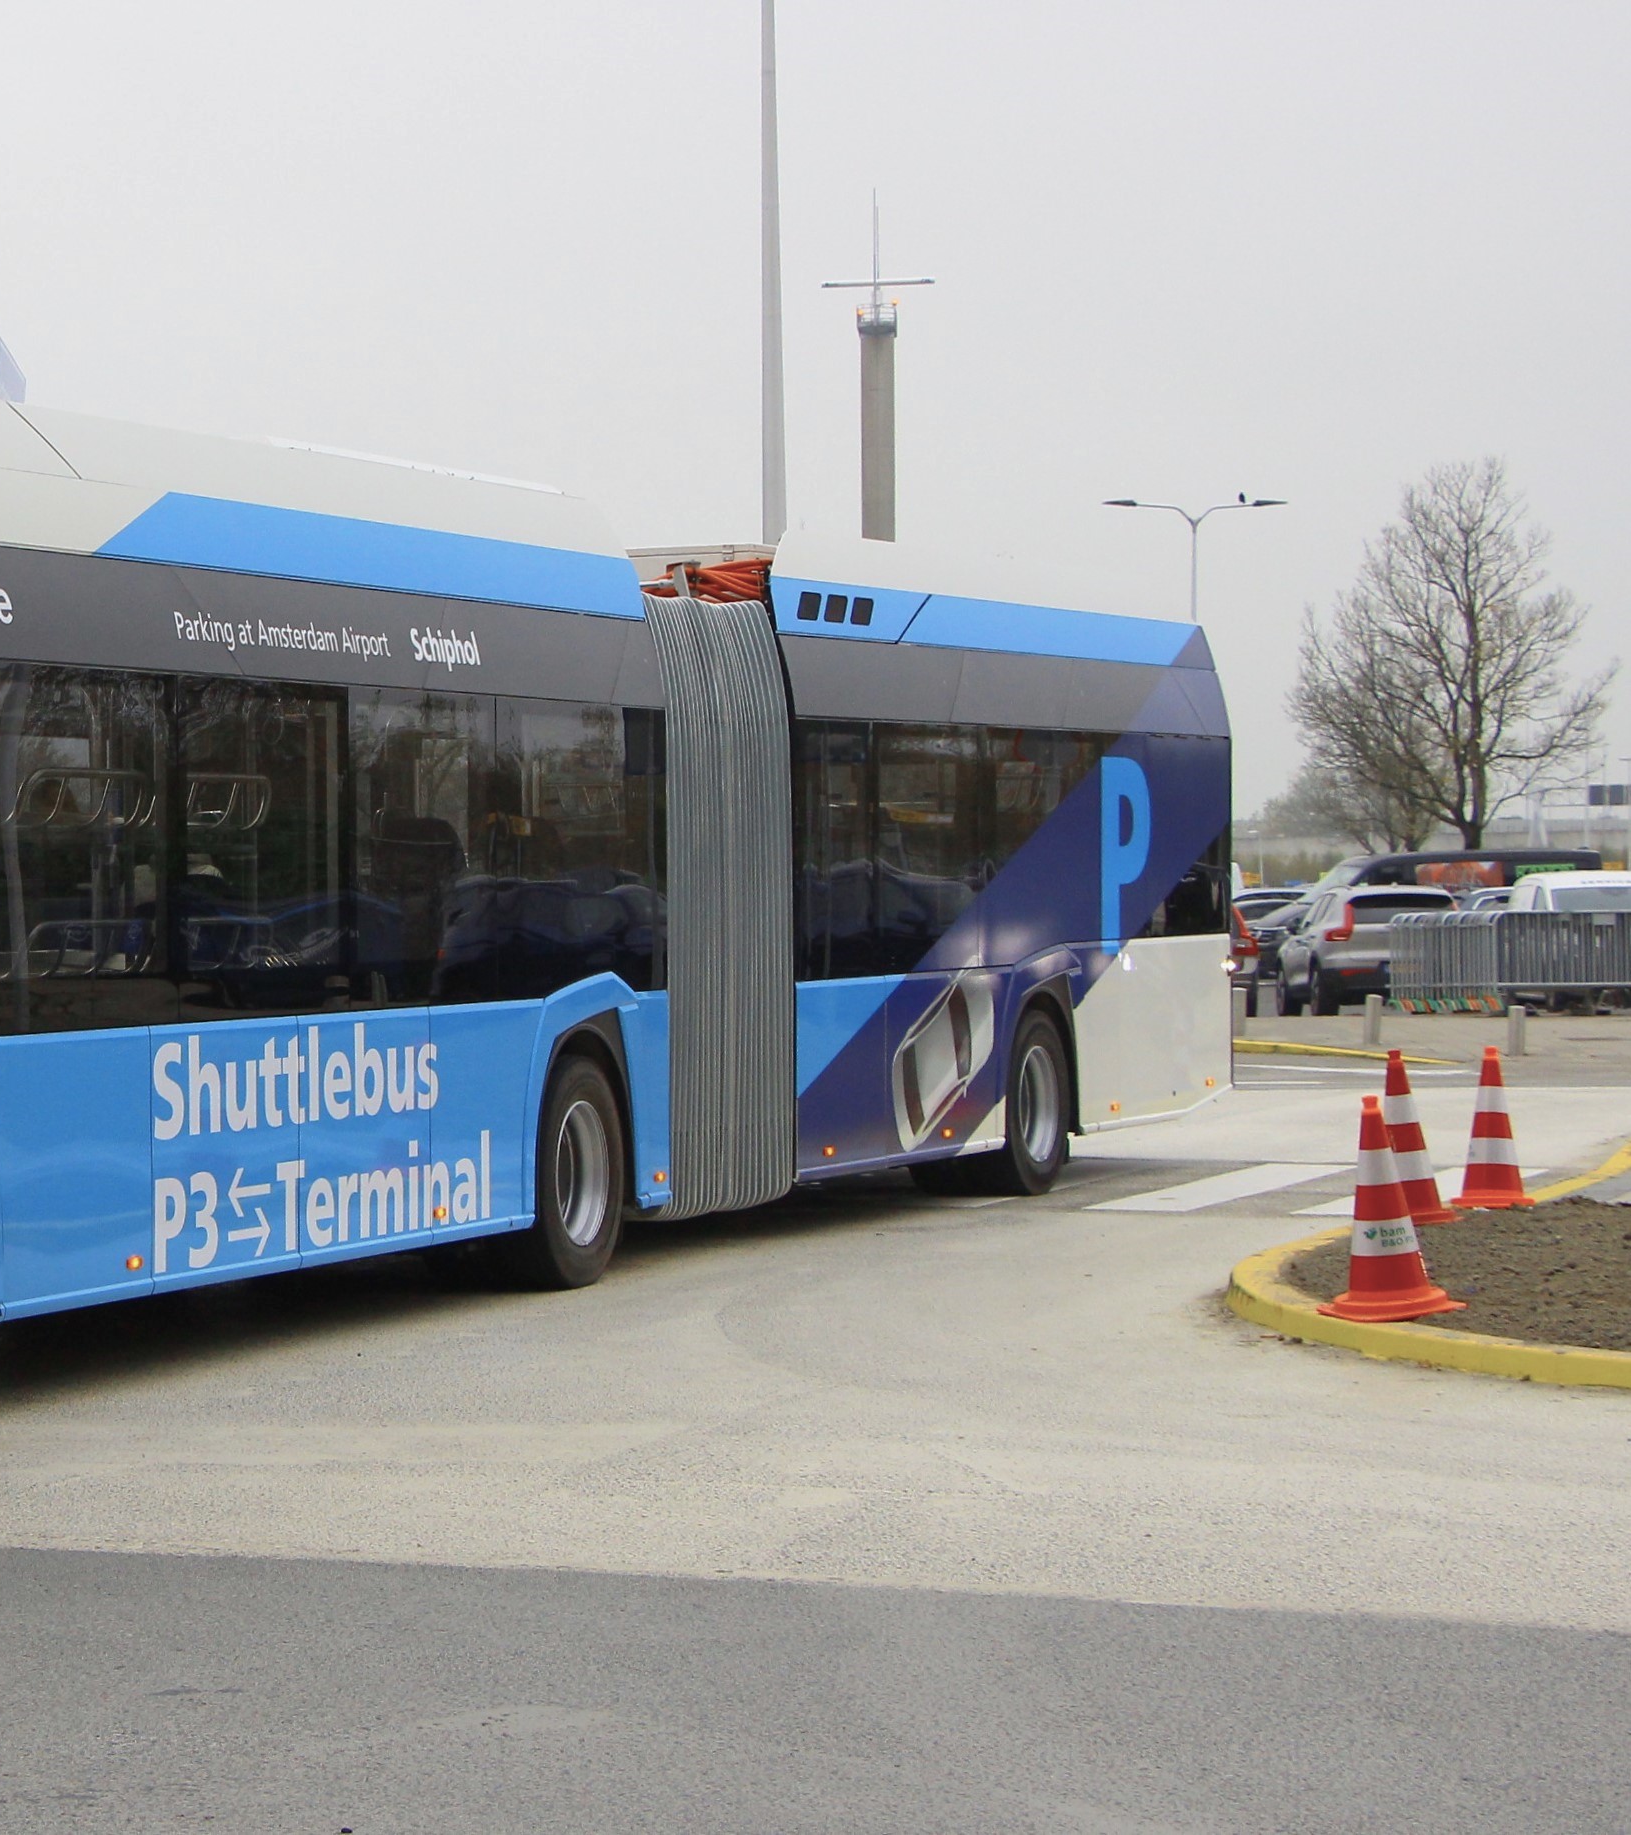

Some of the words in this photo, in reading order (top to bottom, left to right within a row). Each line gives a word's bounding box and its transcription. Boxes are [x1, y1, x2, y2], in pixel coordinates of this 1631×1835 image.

[173, 611, 234, 651] Parking
[238, 619, 255, 646] at
[258, 619, 339, 653] Amsterdam
[342, 626, 391, 662] Airport
[409, 627, 481, 672] Schiphol
[1100, 757, 1151, 954] P
[153, 1022, 439, 1140] Shuttlebus
[154, 1171, 218, 1273] P3
[276, 1129, 491, 1251] Terminal
[1380, 1226, 1406, 1237] bam
